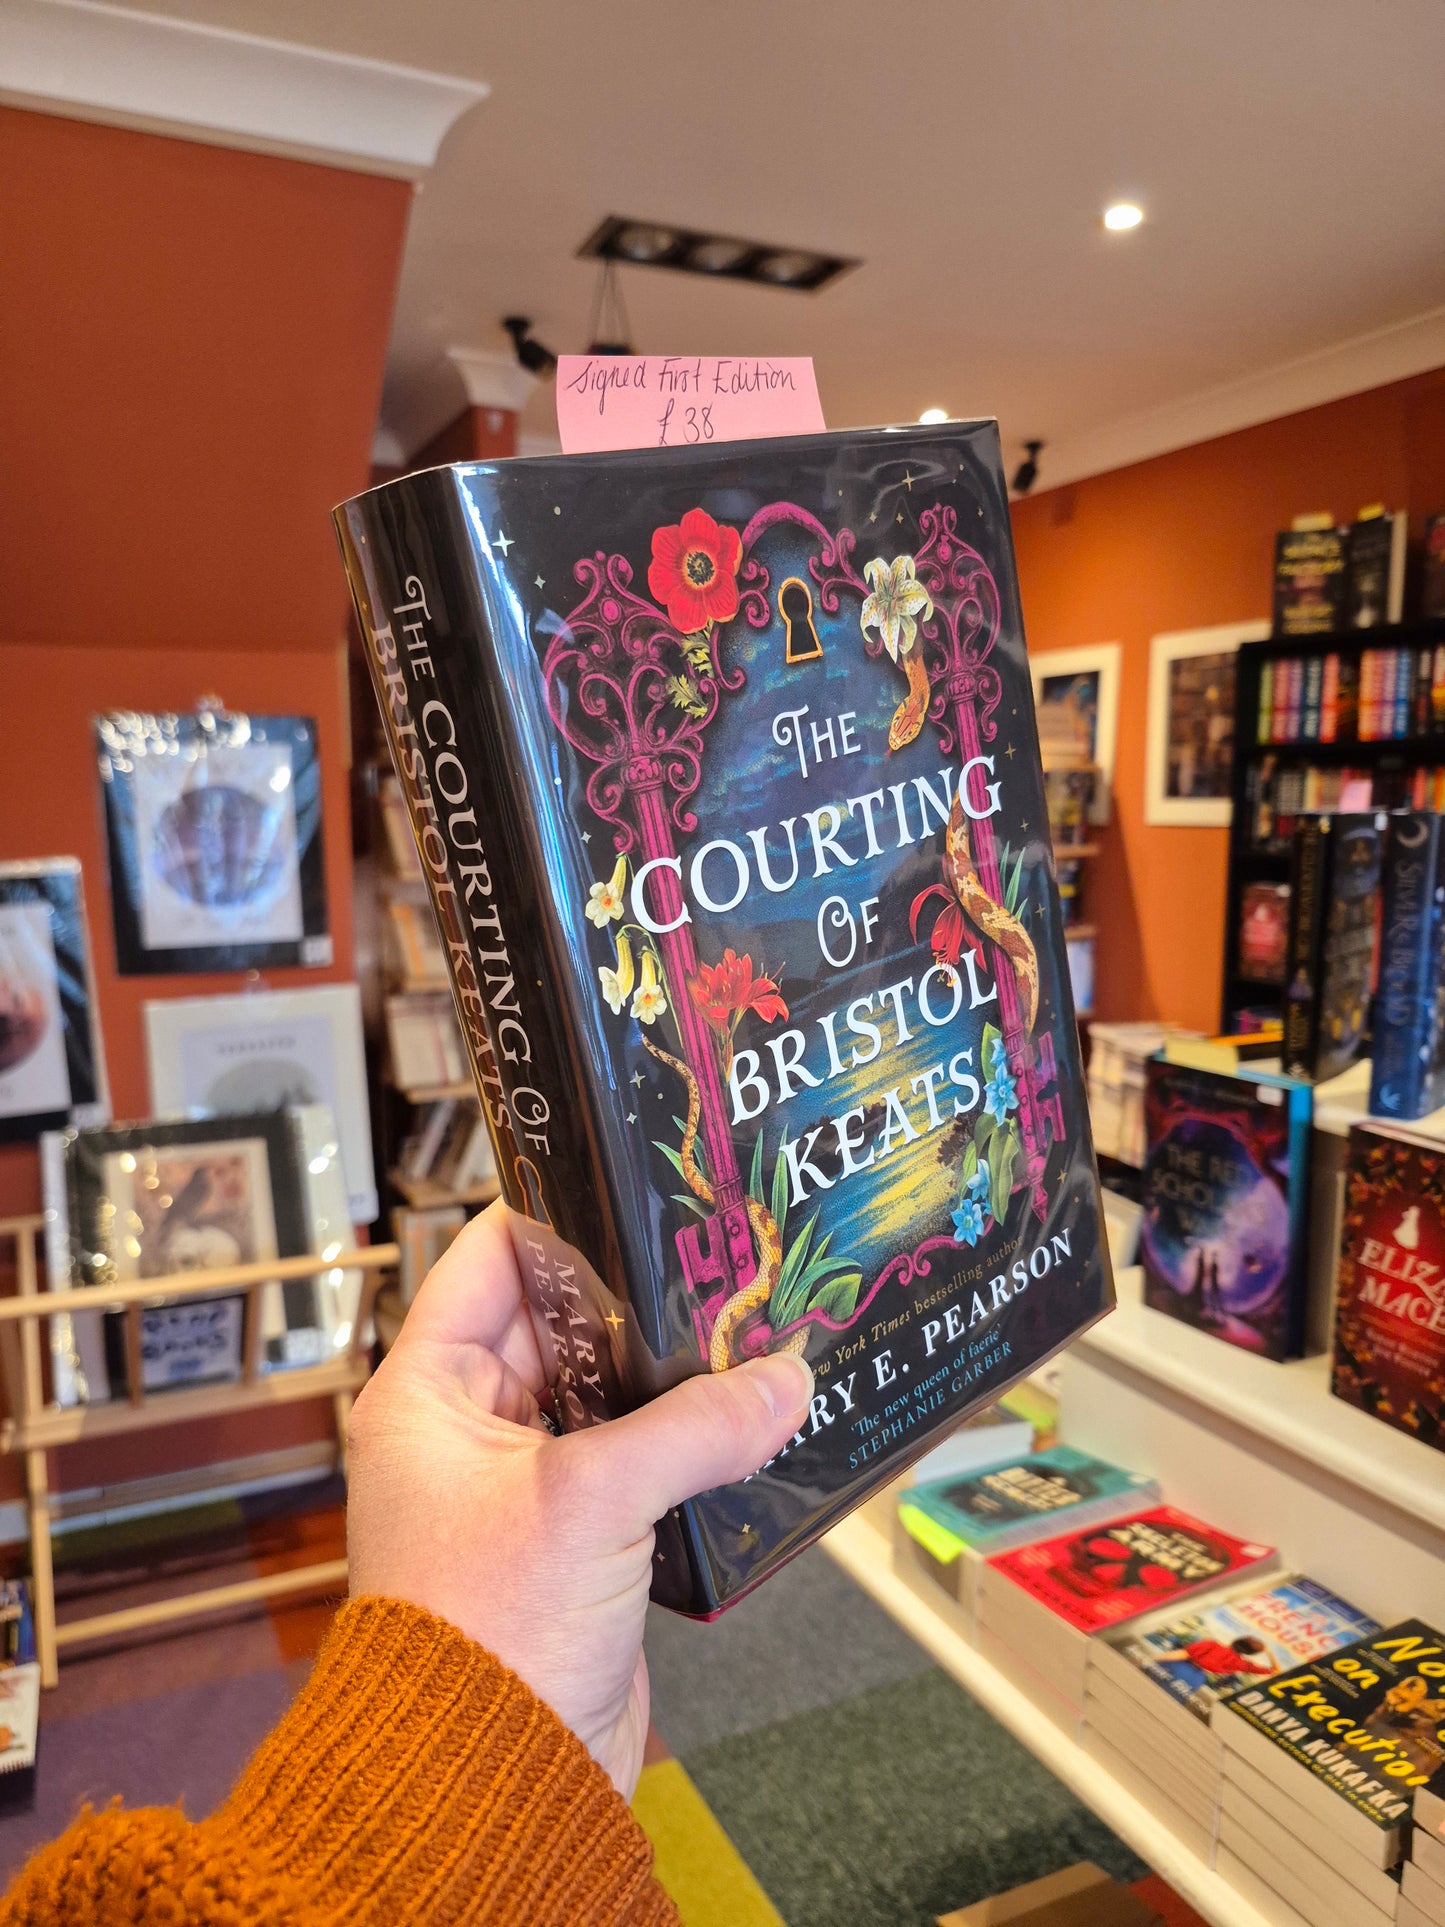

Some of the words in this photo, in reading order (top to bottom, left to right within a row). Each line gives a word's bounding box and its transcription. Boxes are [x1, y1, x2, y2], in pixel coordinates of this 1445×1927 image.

[566, 360, 647, 415] Signed
[659, 357, 702, 393] First
[712, 360, 796, 395] Edition
[657, 398, 714, 446] £38
[772, 705, 861, 778] THE
[370, 622, 462, 912] BRISTOL
[446, 942, 514, 1135] KEATS
[393, 575, 434, 683] THE
[422, 700, 532, 1065] COURTING
[511, 1086, 552, 1156] OF
[630, 755, 1002, 934] COURTING
[817, 894, 880, 968] OF
[730, 949, 997, 1126] BRISTOL
[779, 1048, 981, 1208] KEATS
[525, 1236, 584, 1429] PEARSO
[554, 1258, 605, 1399] MARY
[811, 1361, 831, 1380] ew
[835, 1334, 866, 1365] York
[871, 1310, 910, 1342] Times
[914, 1264, 983, 1315] bestselling
[986, 1236, 1023, 1267] author
[872, 1349, 910, 1392] E.
[921, 1228, 1075, 1358] PEARSON
[849, 1389, 945, 1469] STEPHANIE
[951, 1341, 1012, 1393] GARBER
[884, 1392, 909, 1418] new
[914, 1366, 949, 1399] queen
[953, 1348, 965, 1369] of
[1333, 1658, 1380, 1690] on
[1237, 1691, 1311, 1742] DANYA
[1302, 1738, 1410, 1819] KUKAFKA
